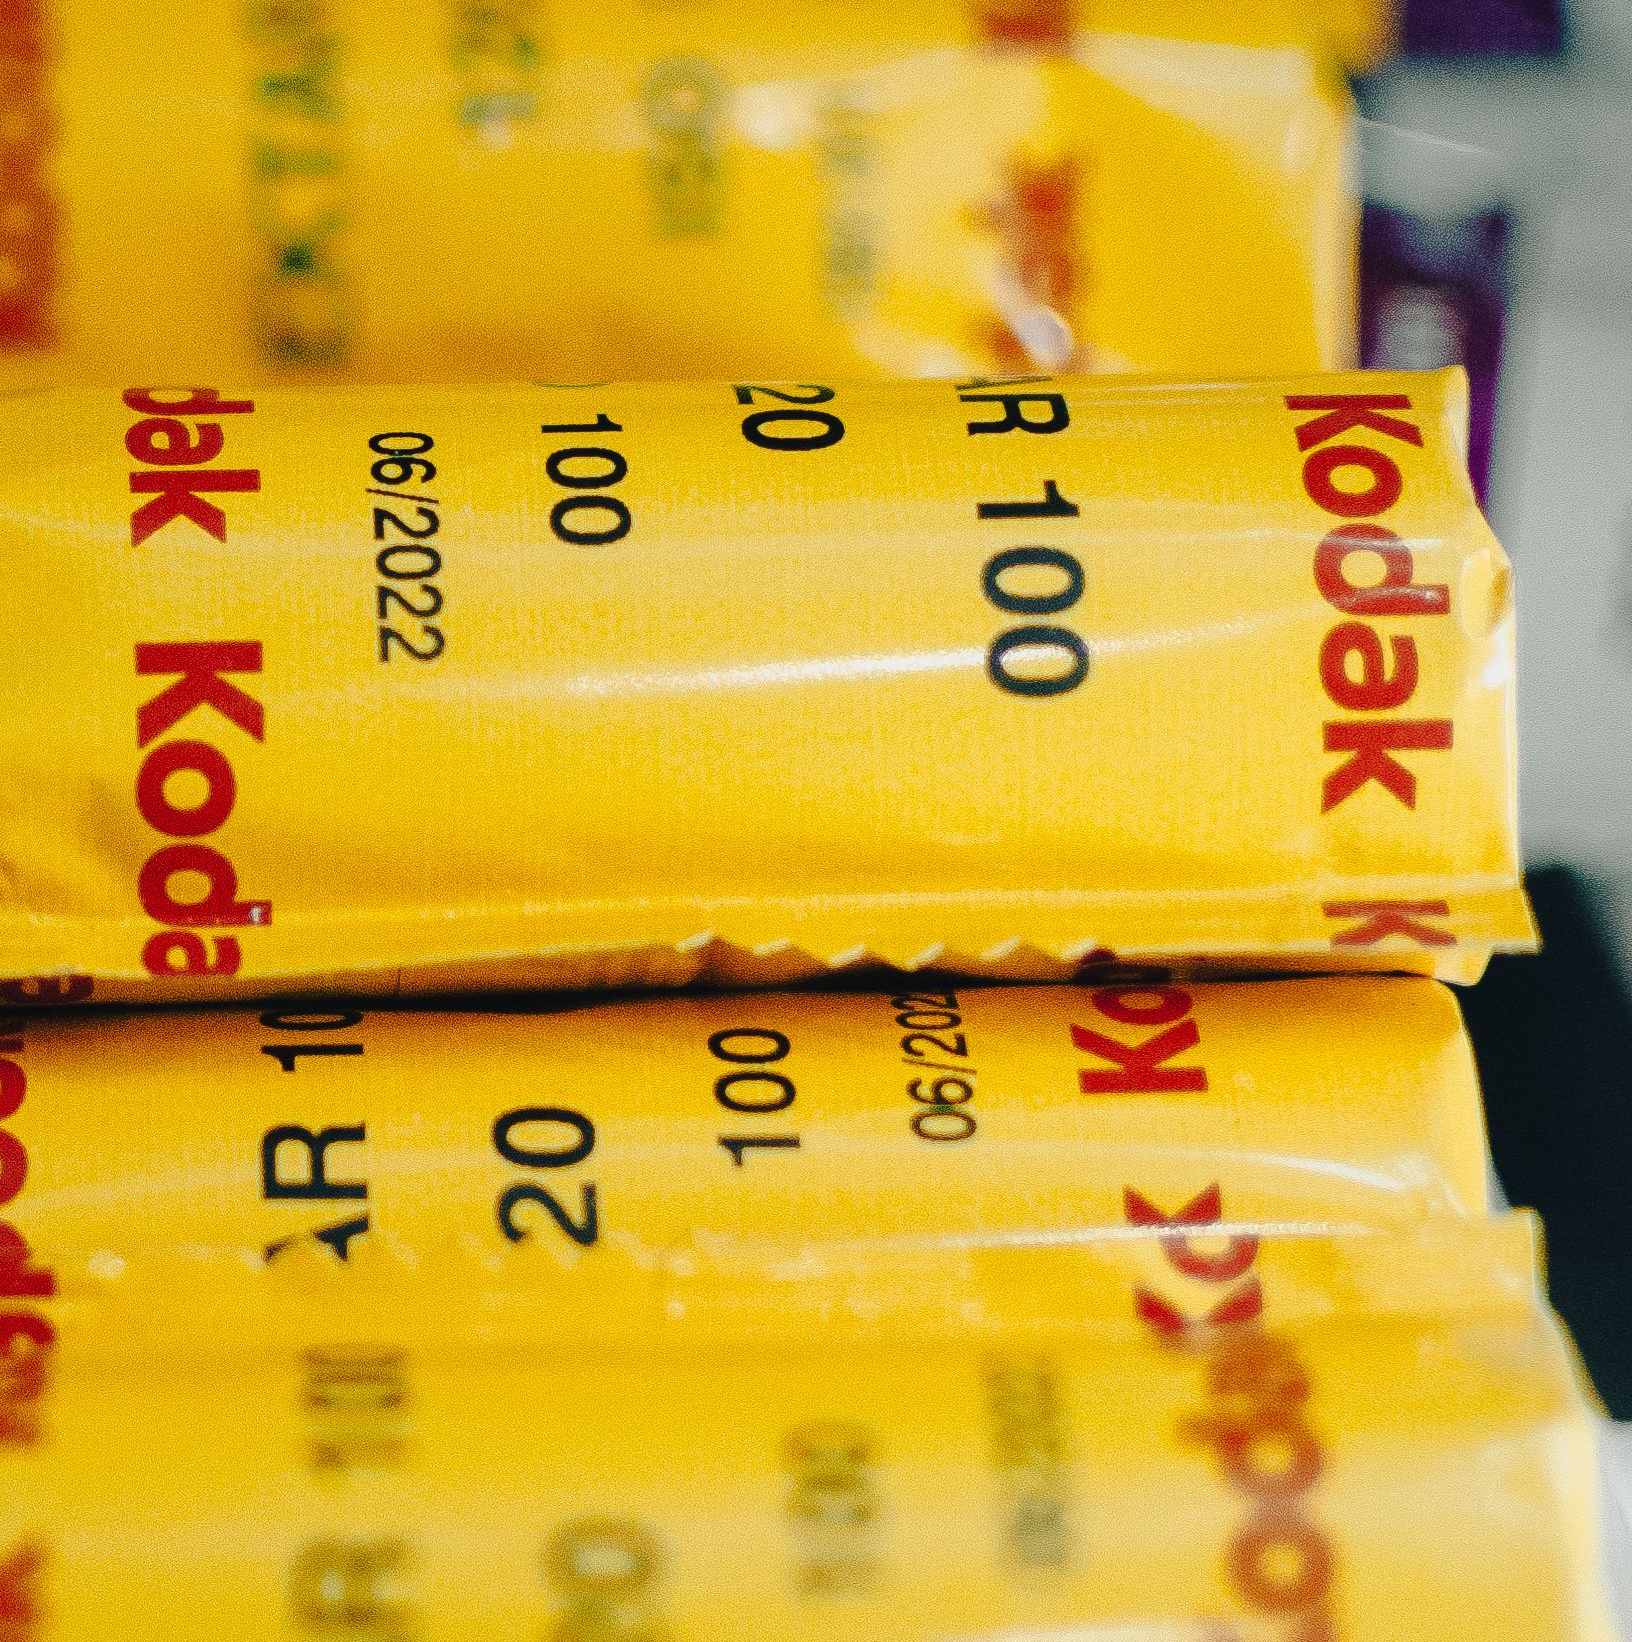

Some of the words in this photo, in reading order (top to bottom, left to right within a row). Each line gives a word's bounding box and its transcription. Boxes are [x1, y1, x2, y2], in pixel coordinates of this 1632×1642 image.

[366, 430, 446, 664] 06/2022
[540, 412, 632, 546] 100
[976, 479, 1092, 699] 100
[1283, 393, 1455, 815] Kodak
[706, 1026, 802, 1168] 100
